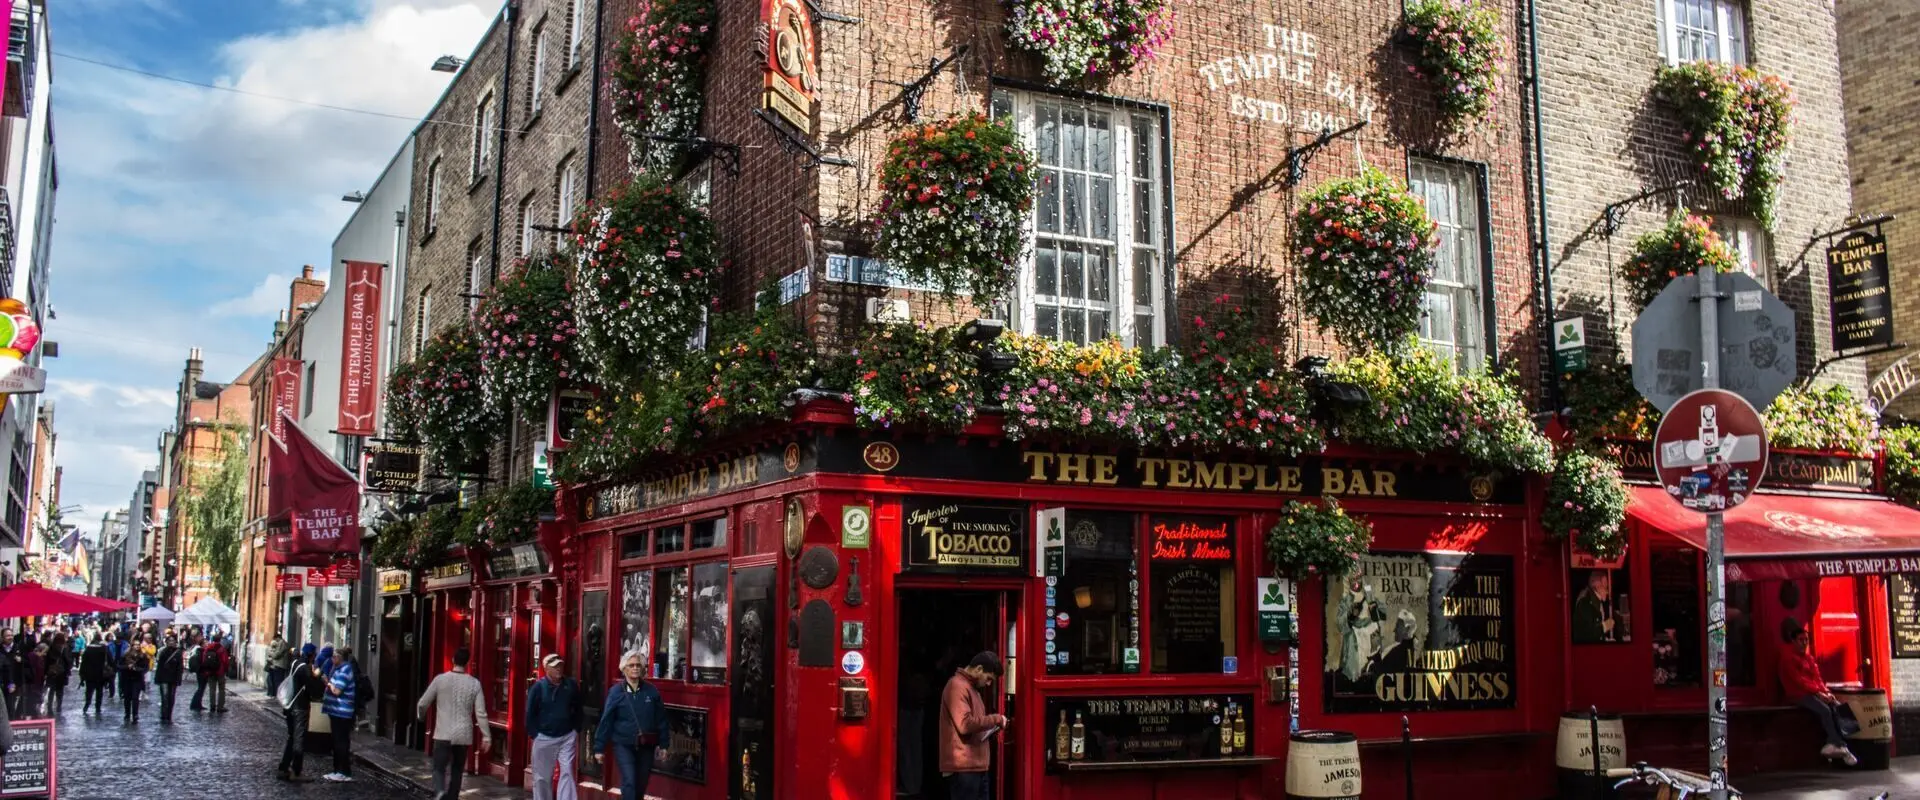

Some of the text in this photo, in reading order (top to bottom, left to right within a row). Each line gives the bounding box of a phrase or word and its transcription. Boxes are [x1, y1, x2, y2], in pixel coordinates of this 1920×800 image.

[1263, 24, 1317, 58] THE
[1199, 53, 1376, 123] TEMPLE BAR
[1301, 109, 1347, 132] 1840
[1846, 236, 1865, 248] THE
[1829, 242, 1885, 264] TEMPLE
[1843, 260, 1873, 276] BAR
[1834, 285, 1886, 303] BEER GARDEN
[1837, 316, 1886, 333] LIVE MUSIC
[1849, 329, 1875, 340] DAILY
[347, 292, 365, 406] THE TEMPLE BAR
[362, 313, 374, 386] TRADING CO.
[285, 380, 295, 401] THE
[1872, 359, 1915, 406] THE
[870, 446, 891, 464] 48
[644, 467, 710, 504] TEMPLE
[718, 454, 760, 491] BAR
[1024, 451, 1397, 496] THE TEMPLE BAR
[295, 514, 353, 529] TEMPLE
[312, 508, 337, 517] THE
[907, 504, 959, 530] Importers
[939, 516, 949, 524] OF
[311, 528, 341, 540] BAR
[952, 522, 1010, 532] FINE SMOKING
[1153, 522, 1228, 540] Traditional
[921, 526, 1011, 561] TOBACCO
[1152, 542, 1231, 560] Irish Music
[939, 555, 1018, 566] Always in Stock
[1360, 561, 1426, 578] TEMPLE
[1816, 557, 1920, 575] THE TEMPLE BA
[1168, 570, 1201, 587] TEMPLE
[1381, 577, 1413, 594] BAR
[1475, 575, 1500, 594] THE
[1443, 596, 1501, 617] EMPEROR
[1487, 619, 1501, 638] OF
[1406, 649, 1457, 669] MALTED
[1375, 672, 1509, 702] GUINNESS
[1088, 699, 1120, 715] THE
[1123, 699, 1184, 714] TEMPLE
[1137, 715, 1170, 725] DUBLIN
[8, 743, 44, 753] OFFEE
[1124, 740, 1139, 750] LIVE
[1163, 739, 1184, 748] DAILY
[1579, 745, 1621, 757] JAESON
[1319, 759, 1333, 767] THE
[5, 772, 45, 782] DONUTS
